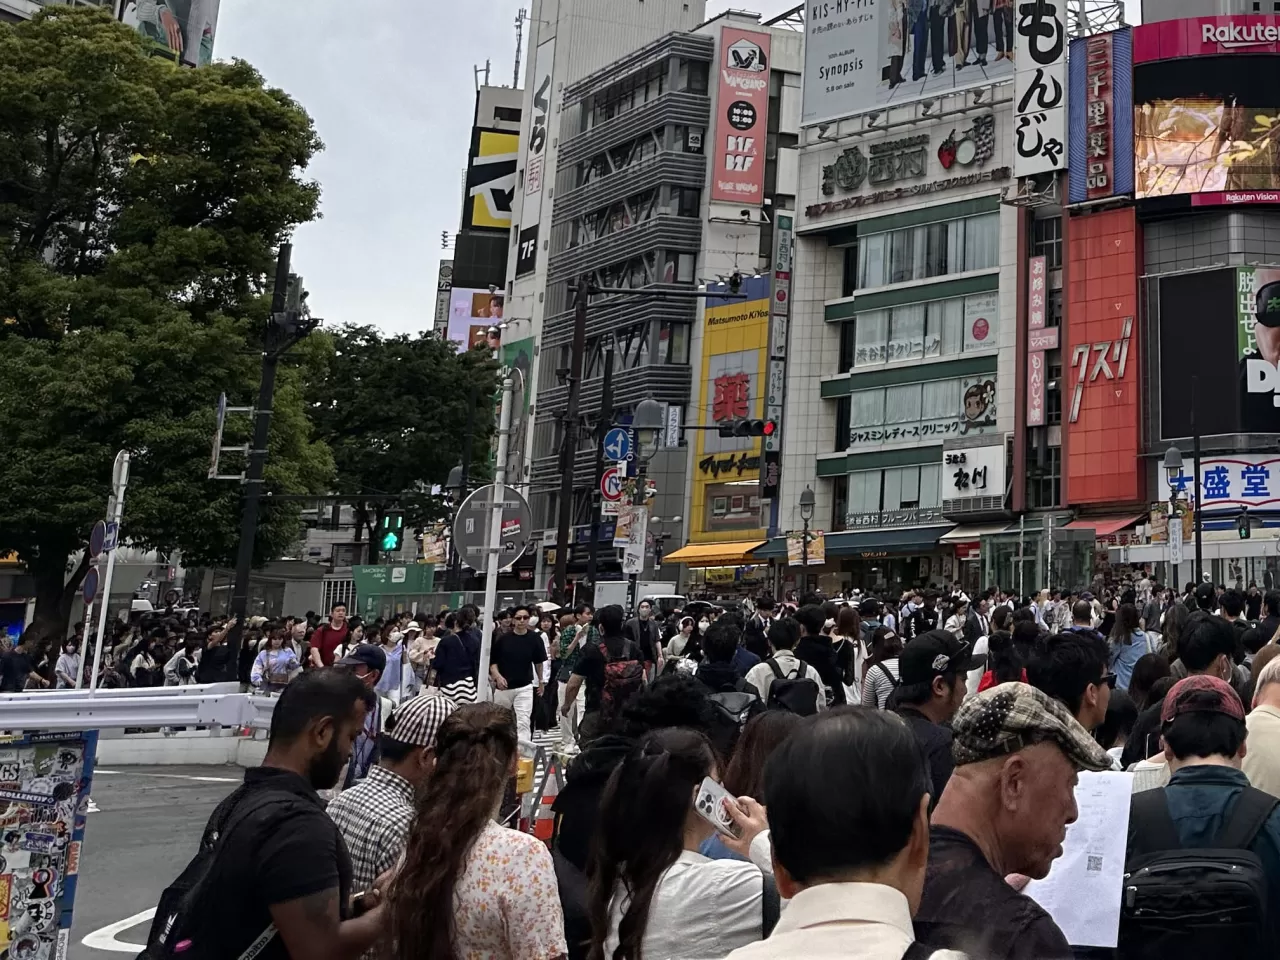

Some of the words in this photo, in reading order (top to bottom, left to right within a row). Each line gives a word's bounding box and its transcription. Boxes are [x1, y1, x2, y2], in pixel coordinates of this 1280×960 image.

[819, 58, 863, 80] Synopsis
[844, 81, 855, 89] sale
[727, 135, 755, 152] B1F
[726, 153, 754, 172] B2F
[1226, 193, 1255, 202] Rakuten
[1256, 192, 1278, 201] Vision
[521, 239, 536, 261] 7F
[707, 313, 748, 326] Matsumoto
[1238, 271, 1258, 356] 脱出せよ
[1069, 315, 1134, 424] クスリ
[712, 372, 750, 423] 薬
